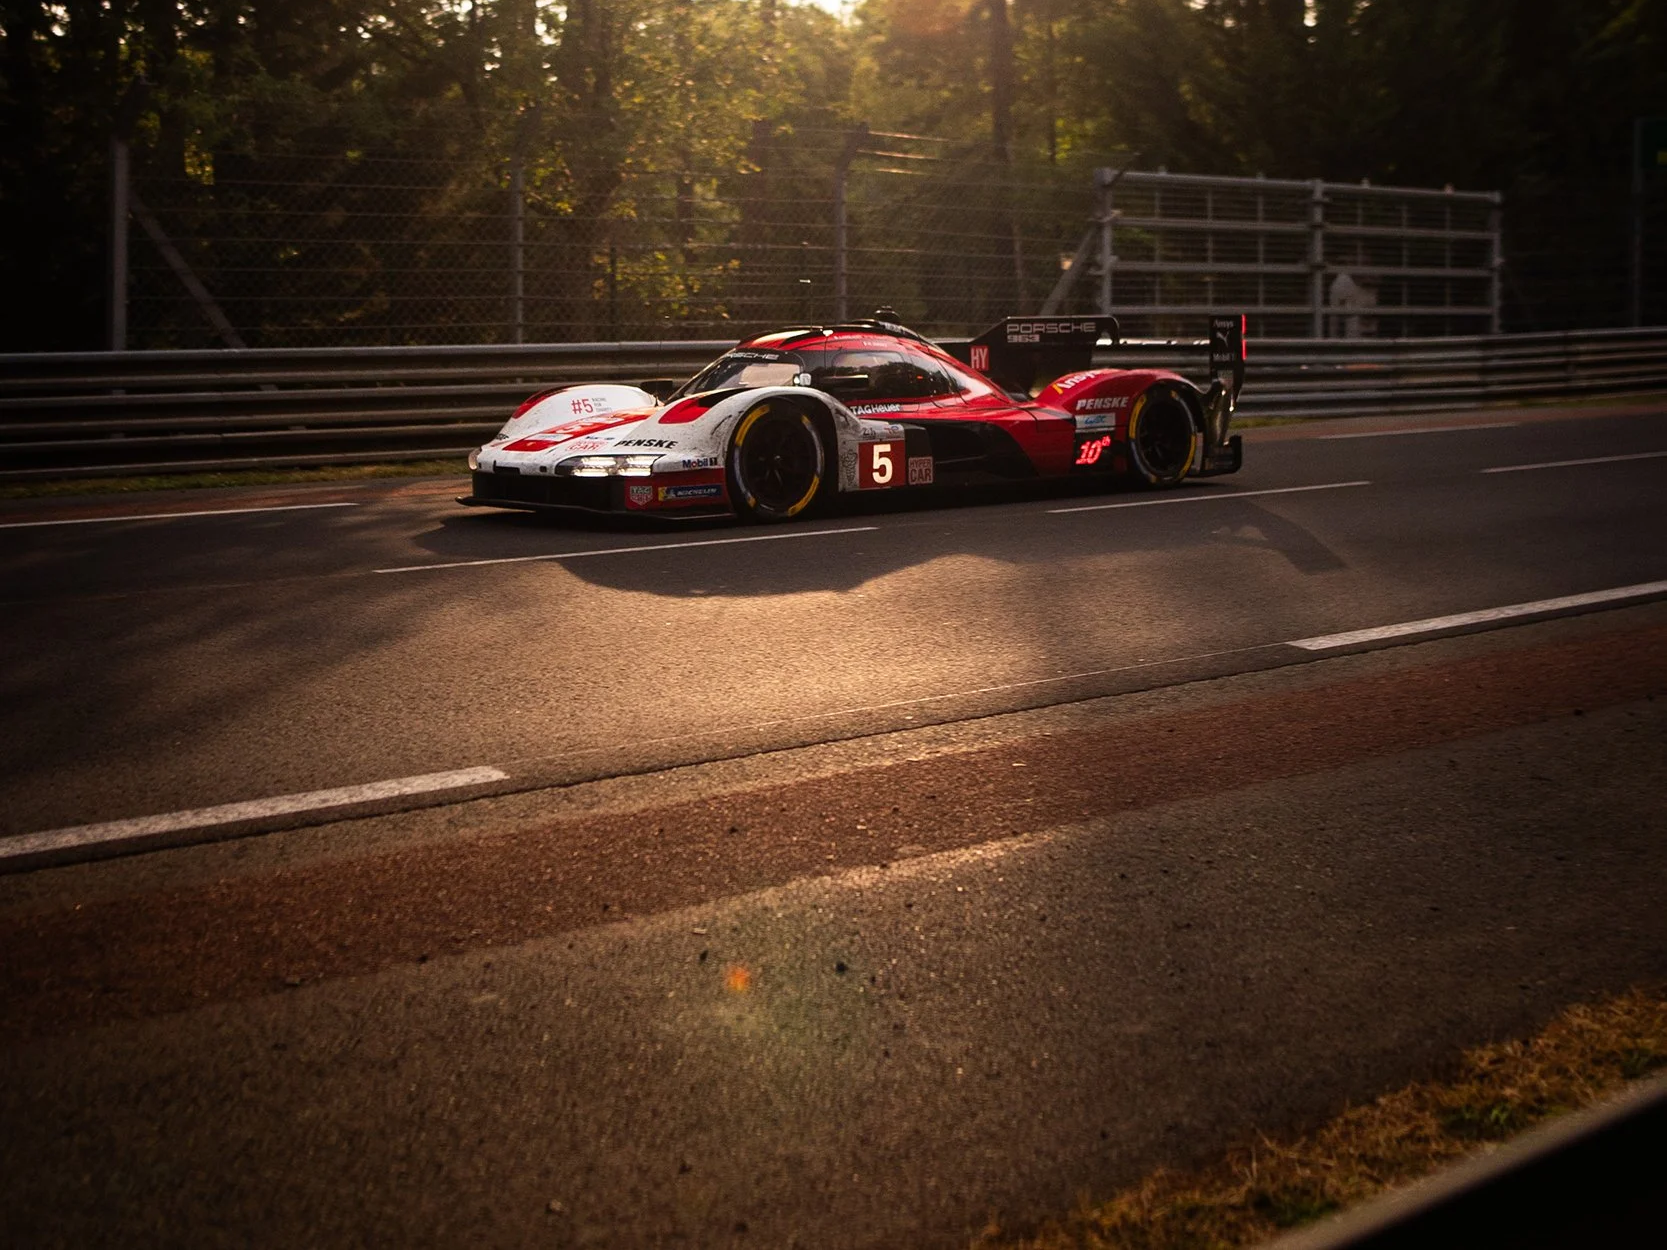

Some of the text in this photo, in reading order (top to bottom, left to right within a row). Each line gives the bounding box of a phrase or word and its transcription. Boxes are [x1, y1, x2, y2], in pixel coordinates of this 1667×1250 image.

[1006, 321, 1096, 334] PORSCHE
[1006, 334, 1040, 343] 963
[970, 347, 989, 369] HY
[571, 398, 594, 414] #5
[1075, 396, 1130, 411] PENSKE
[613, 439, 679, 450] PENSKE
[682, 458, 708, 469] Mobil
[872, 443, 893, 484] 5
[909, 458, 932, 468] HYPER
[909, 468, 932, 483] CAR
[677, 488, 717, 497] MICHELIN
